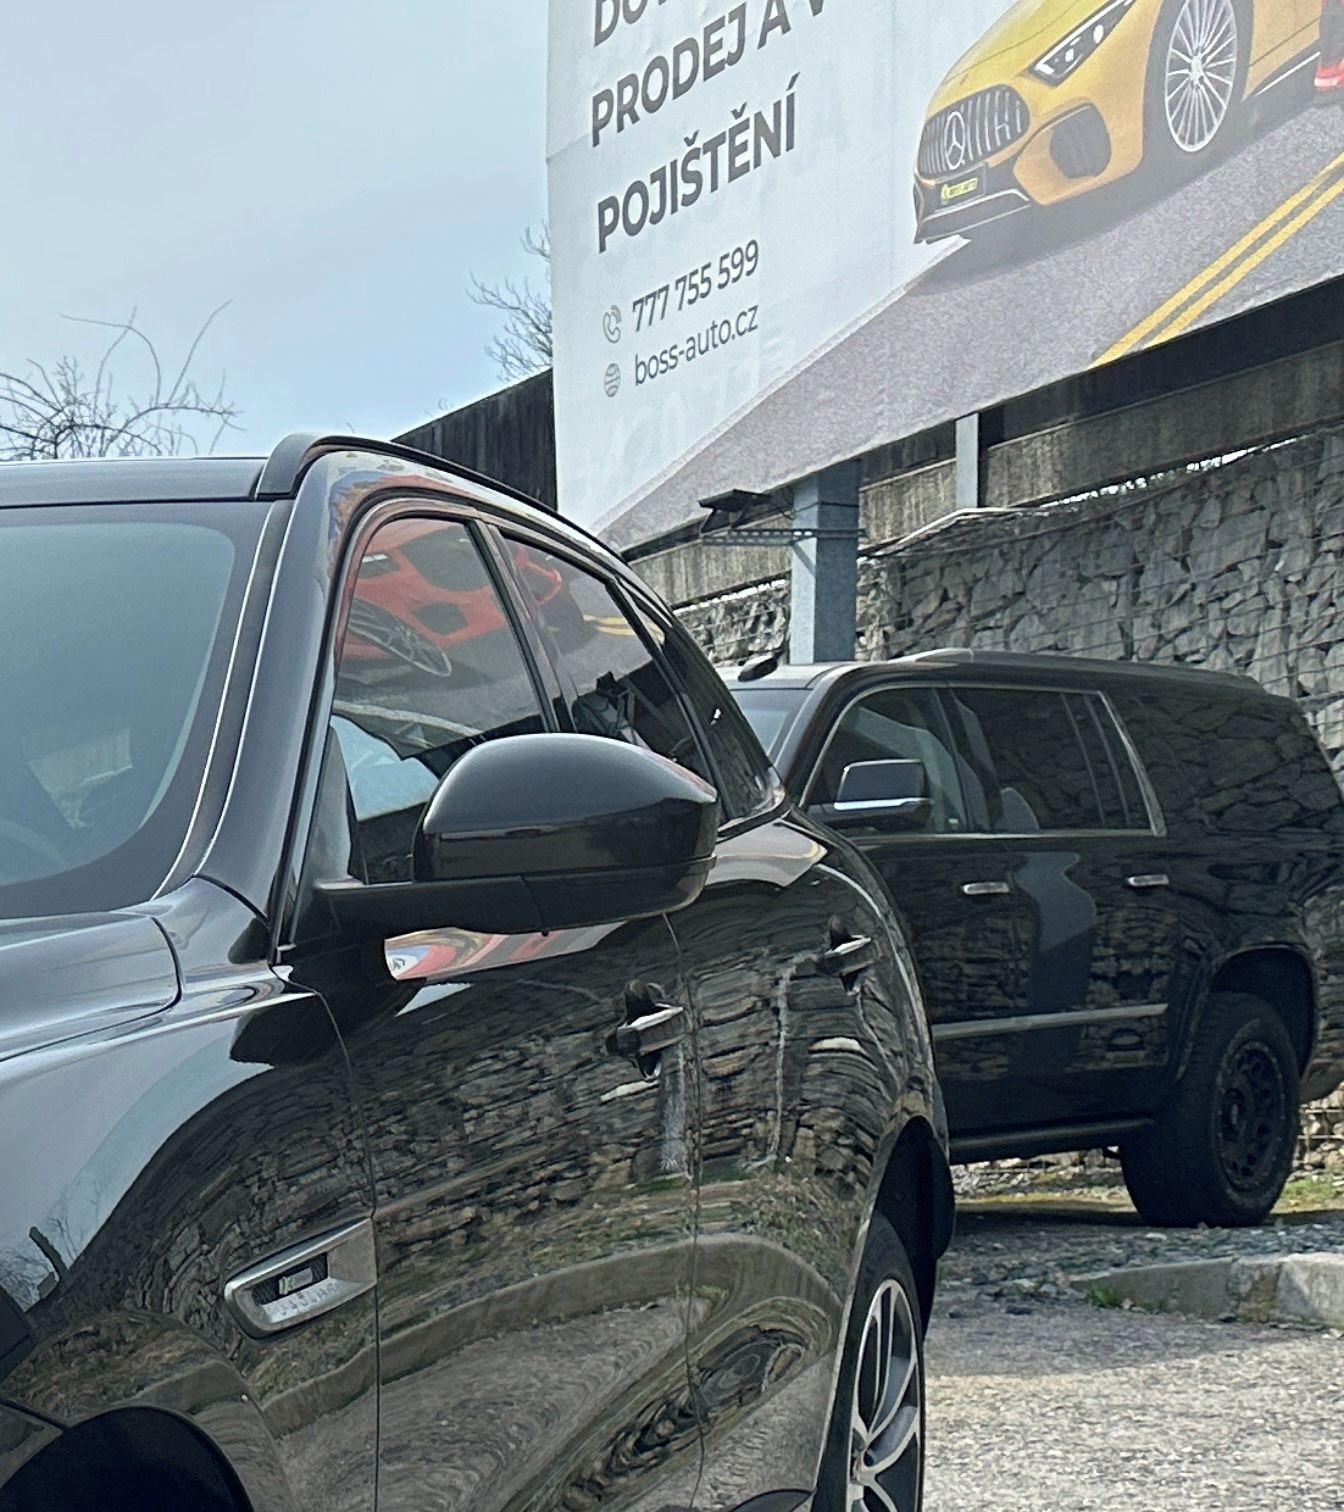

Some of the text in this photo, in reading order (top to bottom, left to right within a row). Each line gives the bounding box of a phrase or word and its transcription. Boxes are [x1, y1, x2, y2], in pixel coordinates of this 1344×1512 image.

[592, 2, 747, 148] PRODEJ
[757, 0, 791, 50] A
[597, 72, 800, 254] POJIŠTĚNÍ
[632, 239, 759, 332] 777 755 599
[634, 305, 759, 386] boss-auto.cz
